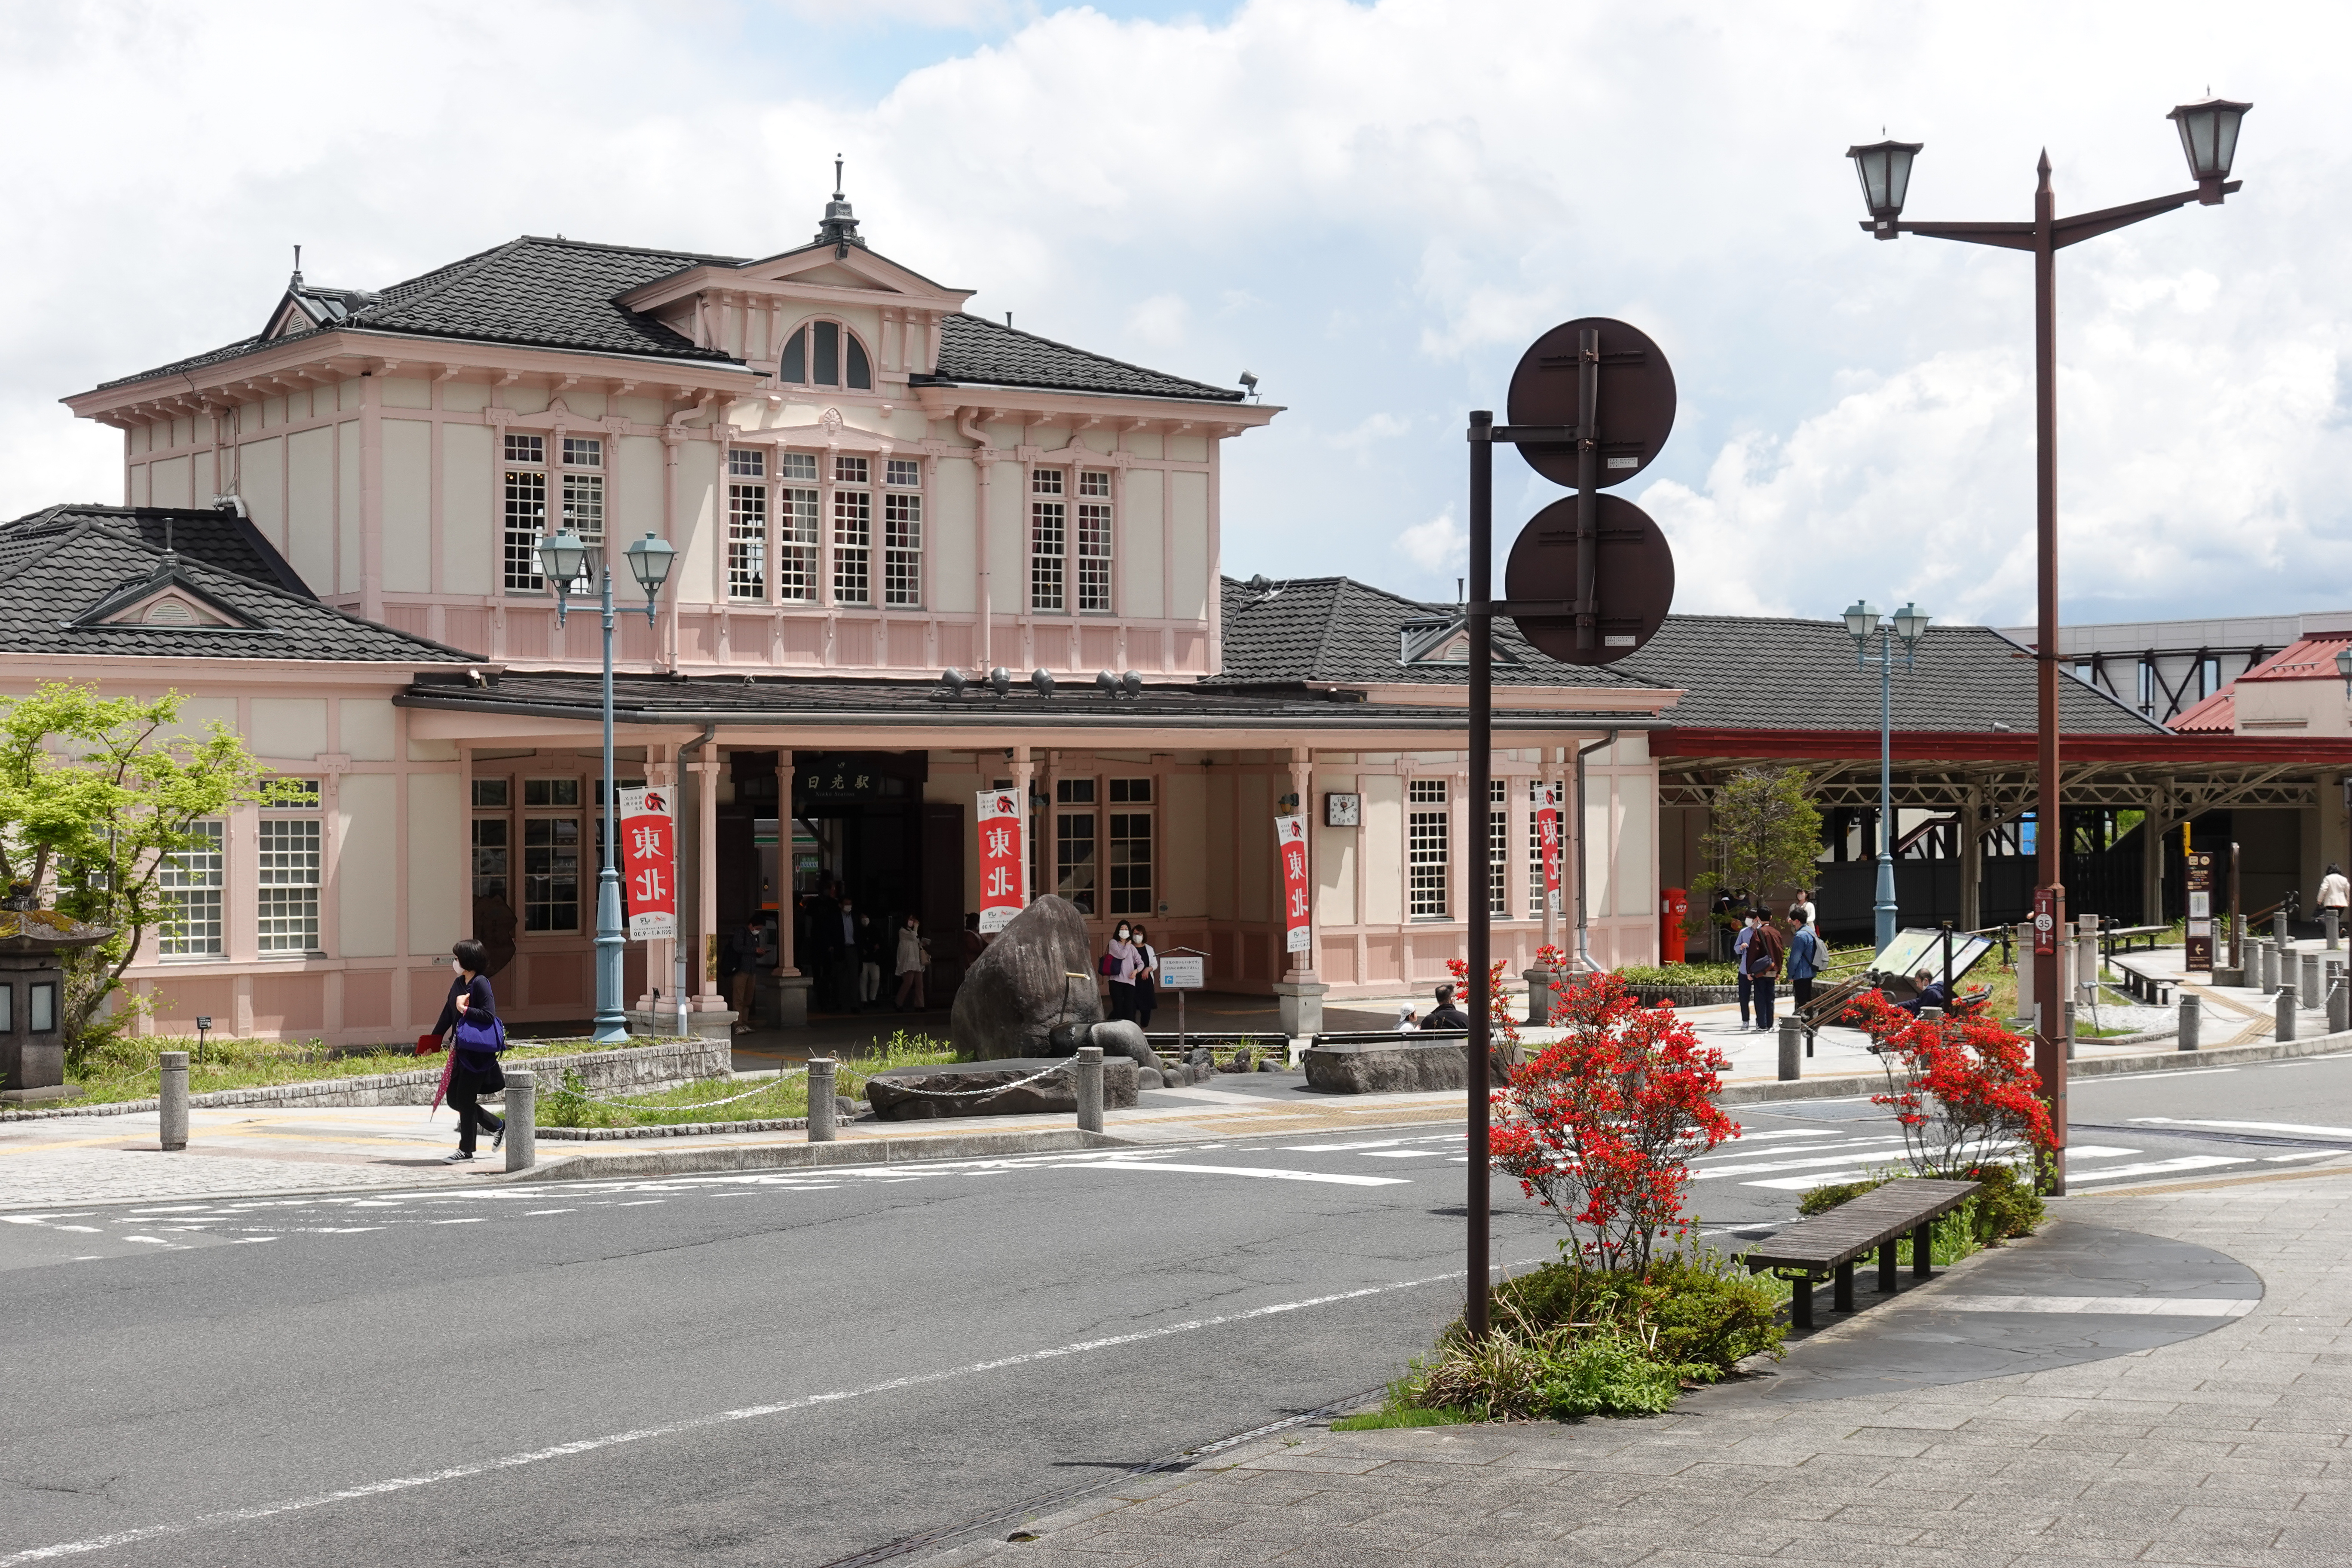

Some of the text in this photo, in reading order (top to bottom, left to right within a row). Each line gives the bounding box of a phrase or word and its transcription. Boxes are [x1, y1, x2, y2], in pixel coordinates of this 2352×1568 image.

[808, 774, 869, 789] 日光駅
[2038, 919, 2050, 928] 35
